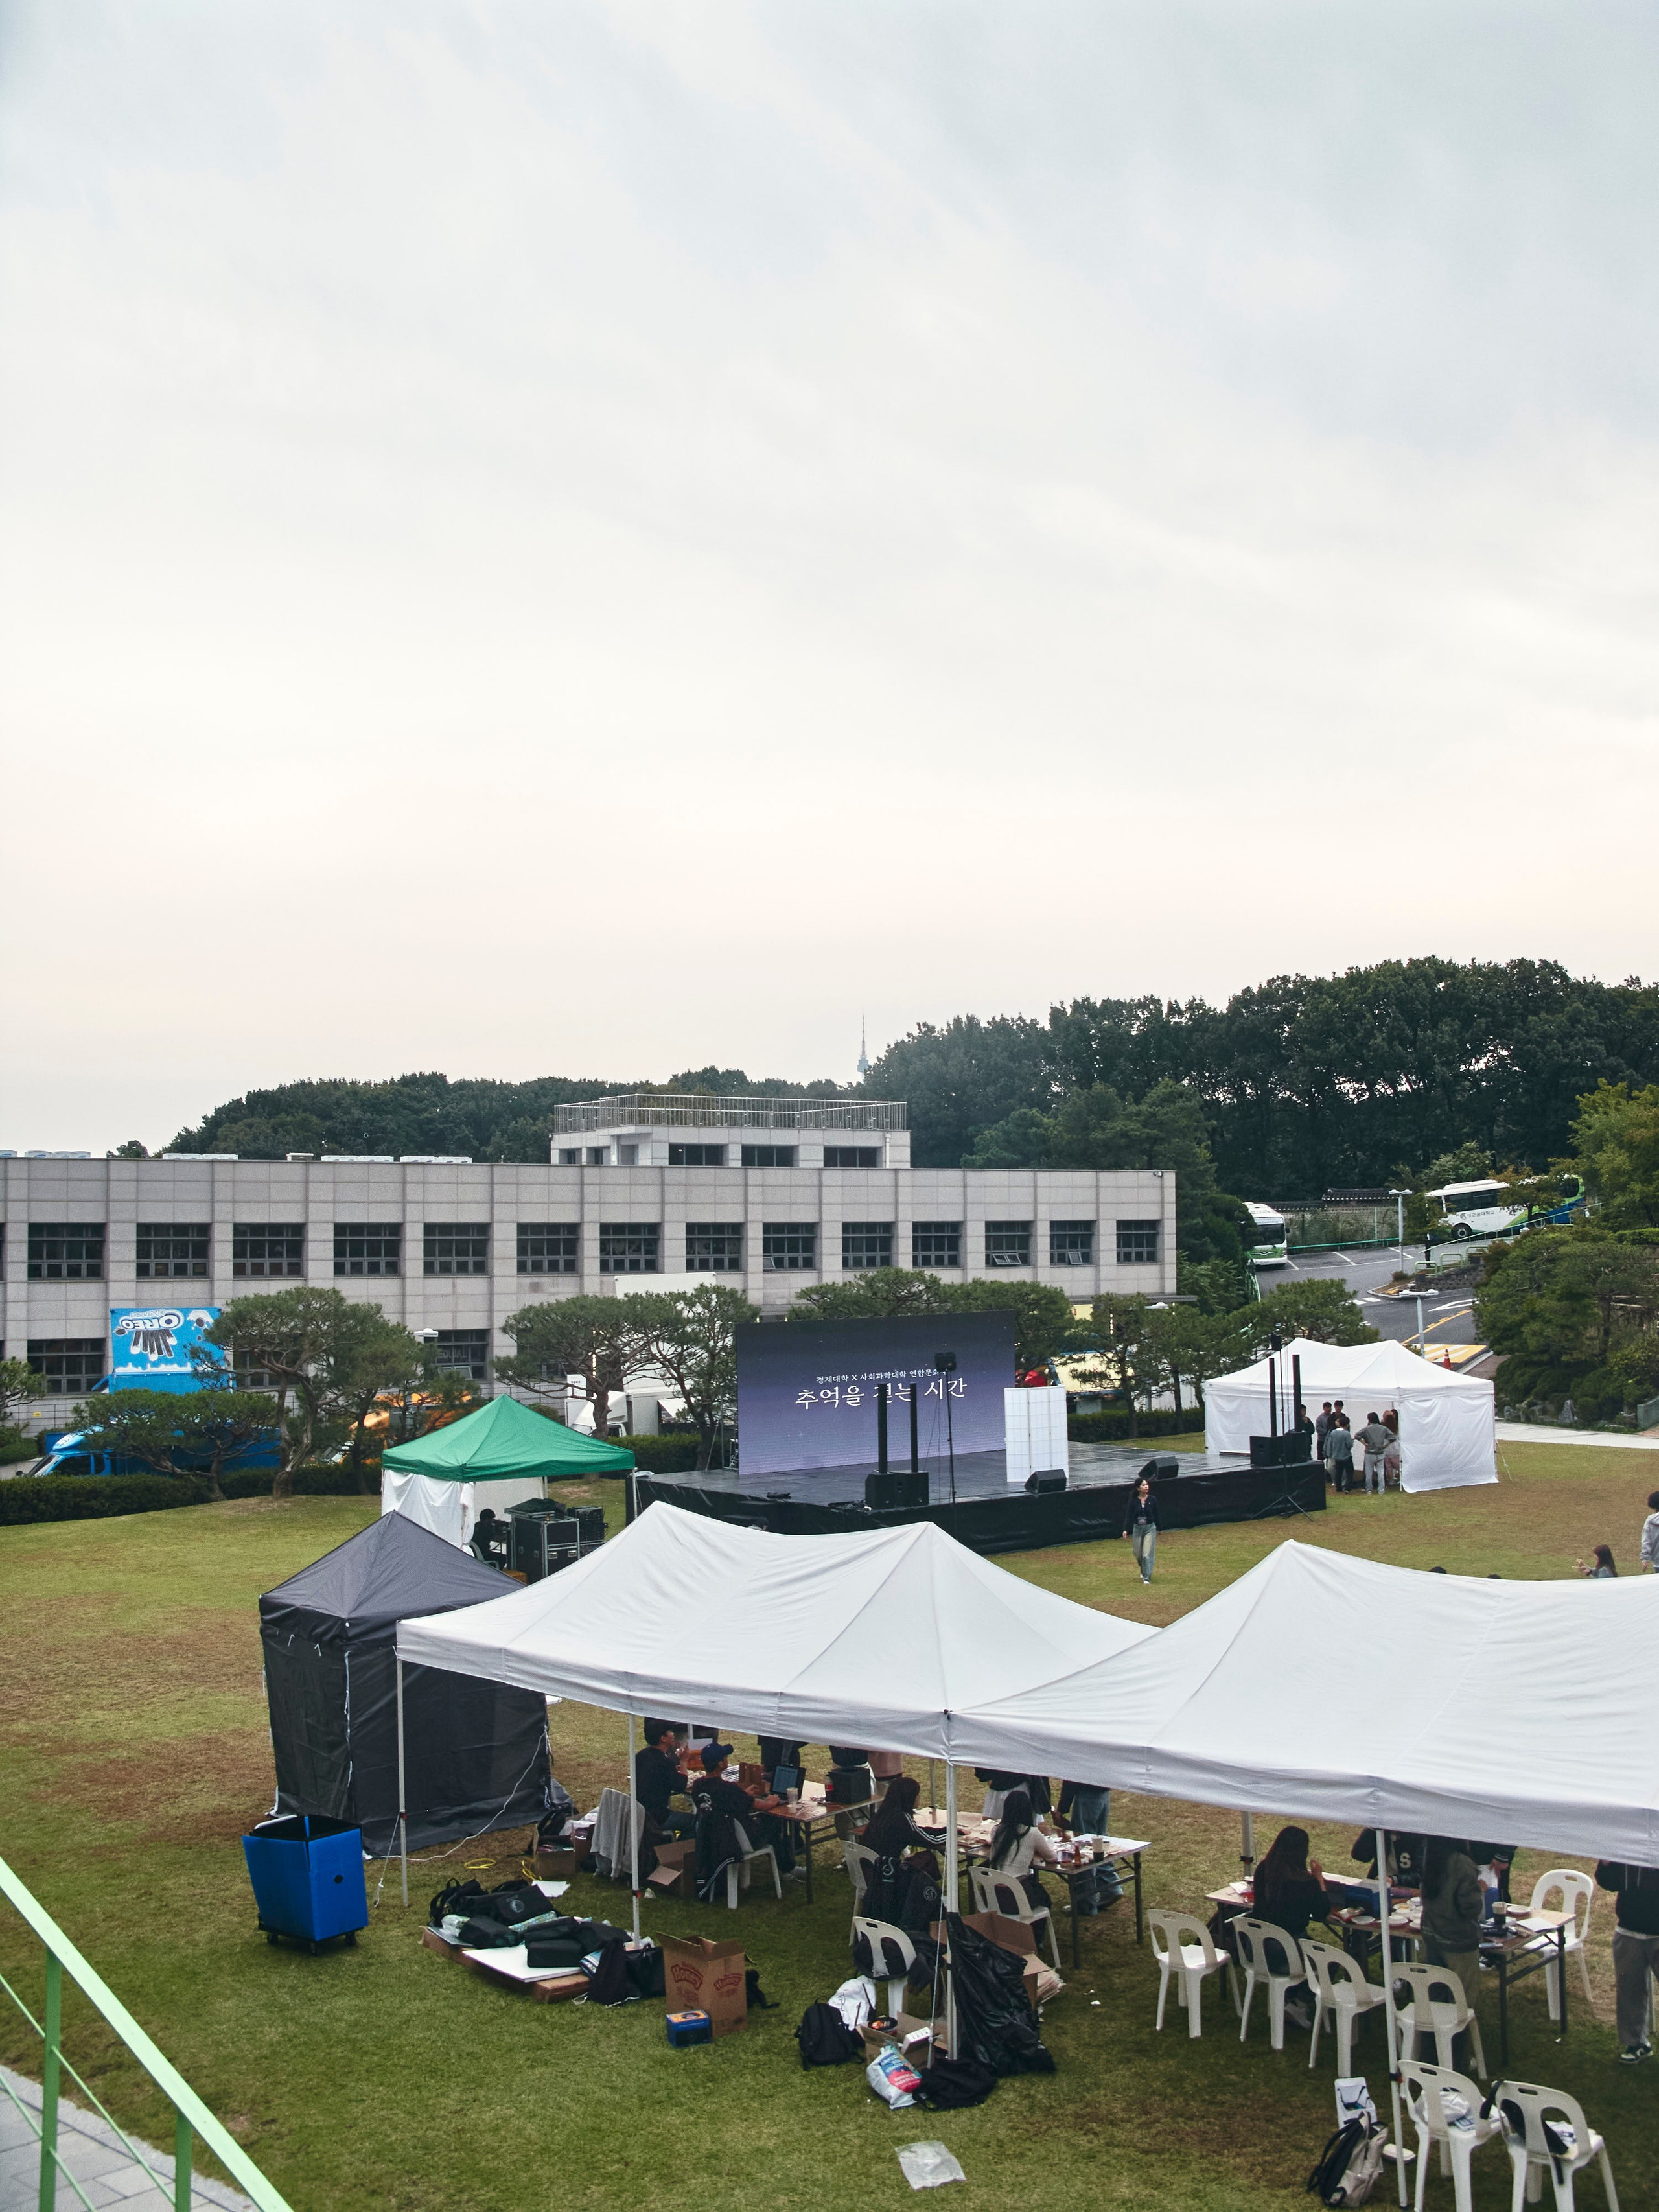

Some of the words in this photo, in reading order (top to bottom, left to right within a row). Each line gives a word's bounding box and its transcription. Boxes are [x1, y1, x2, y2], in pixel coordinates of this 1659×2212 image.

[121, 1314, 180, 1329] OREO
[817, 1375, 849, 1384] 경제대학
[859, 1370, 907, 1381] 사회과학대학
[909, 1369, 946, 1378] 연합문화
[795, 1385, 865, 1410] 추억을
[924, 1377, 968, 1400] 시간
[1400, 1852, 1411, 1869] S
